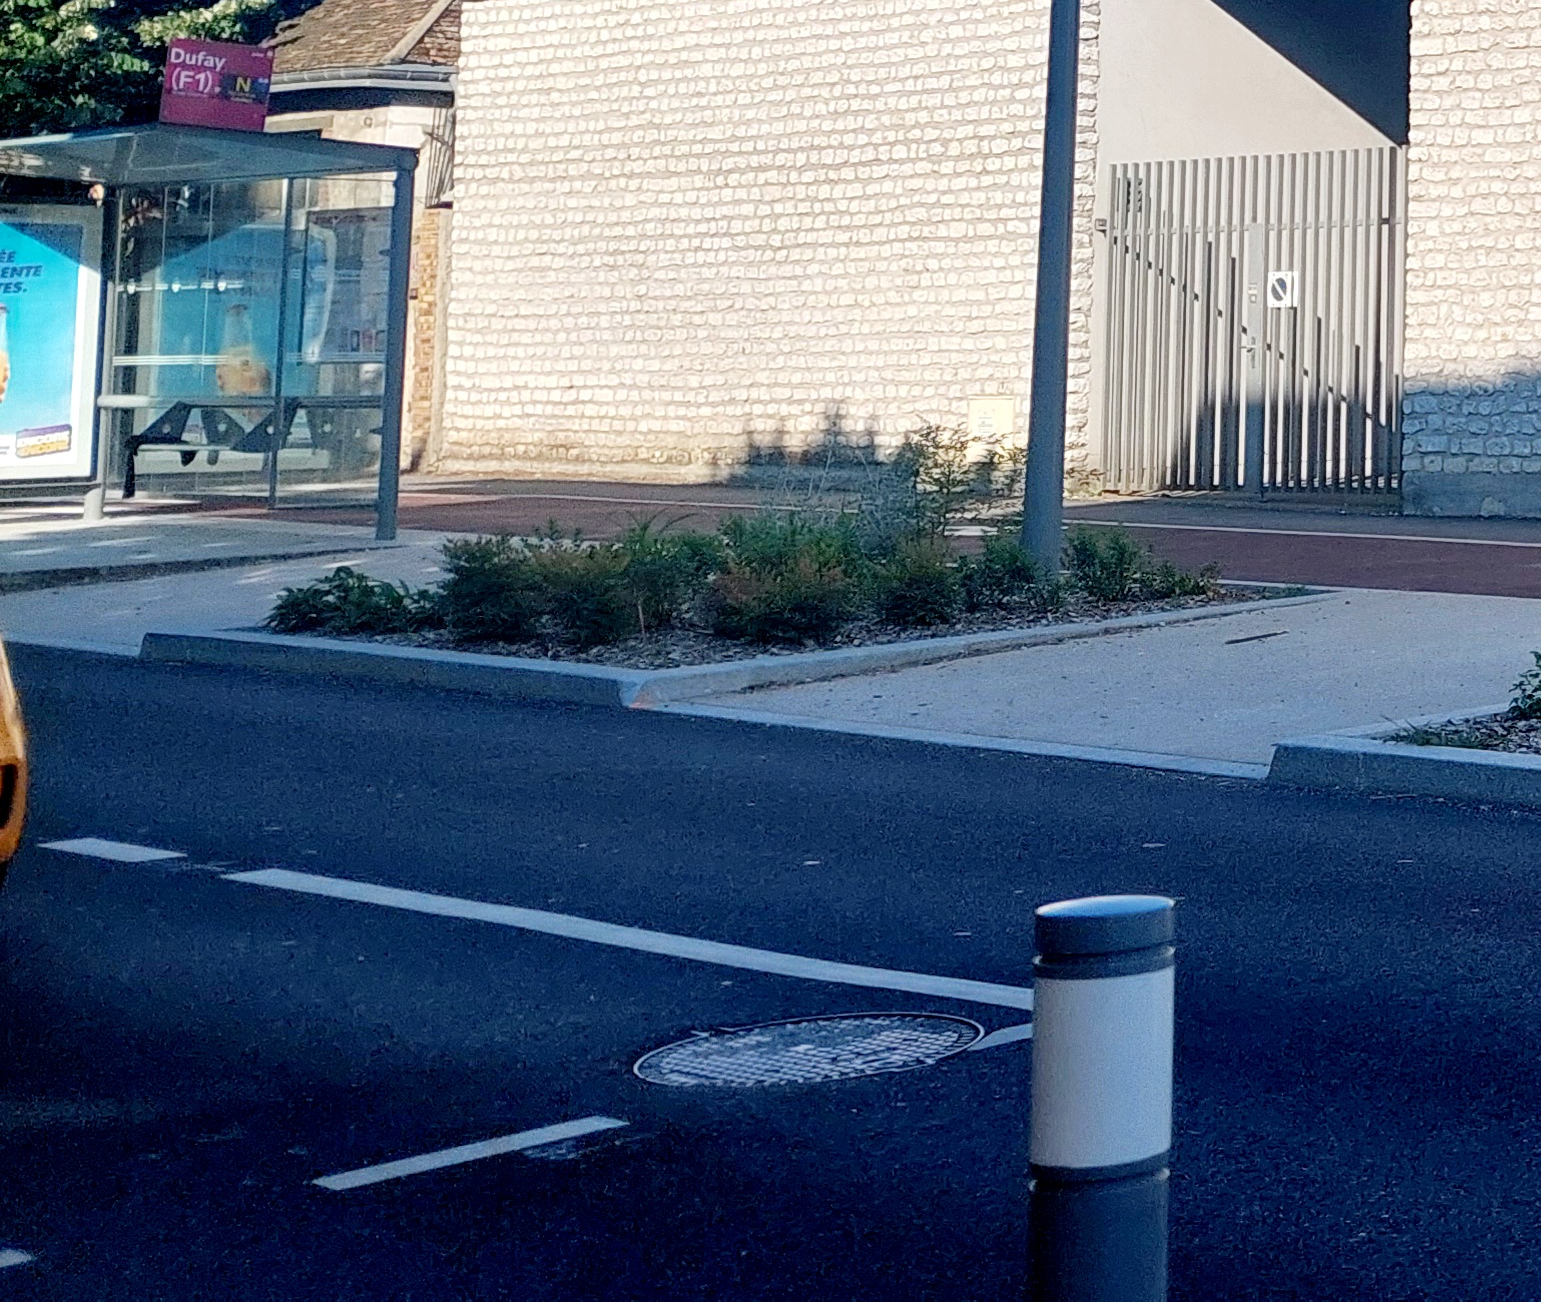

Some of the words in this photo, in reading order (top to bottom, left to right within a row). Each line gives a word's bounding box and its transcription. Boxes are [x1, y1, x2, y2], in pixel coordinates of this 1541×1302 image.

[170, 47, 226, 72] Dufay
[171, 68, 213, 93] (F1)
[235, 76, 252, 92] N
